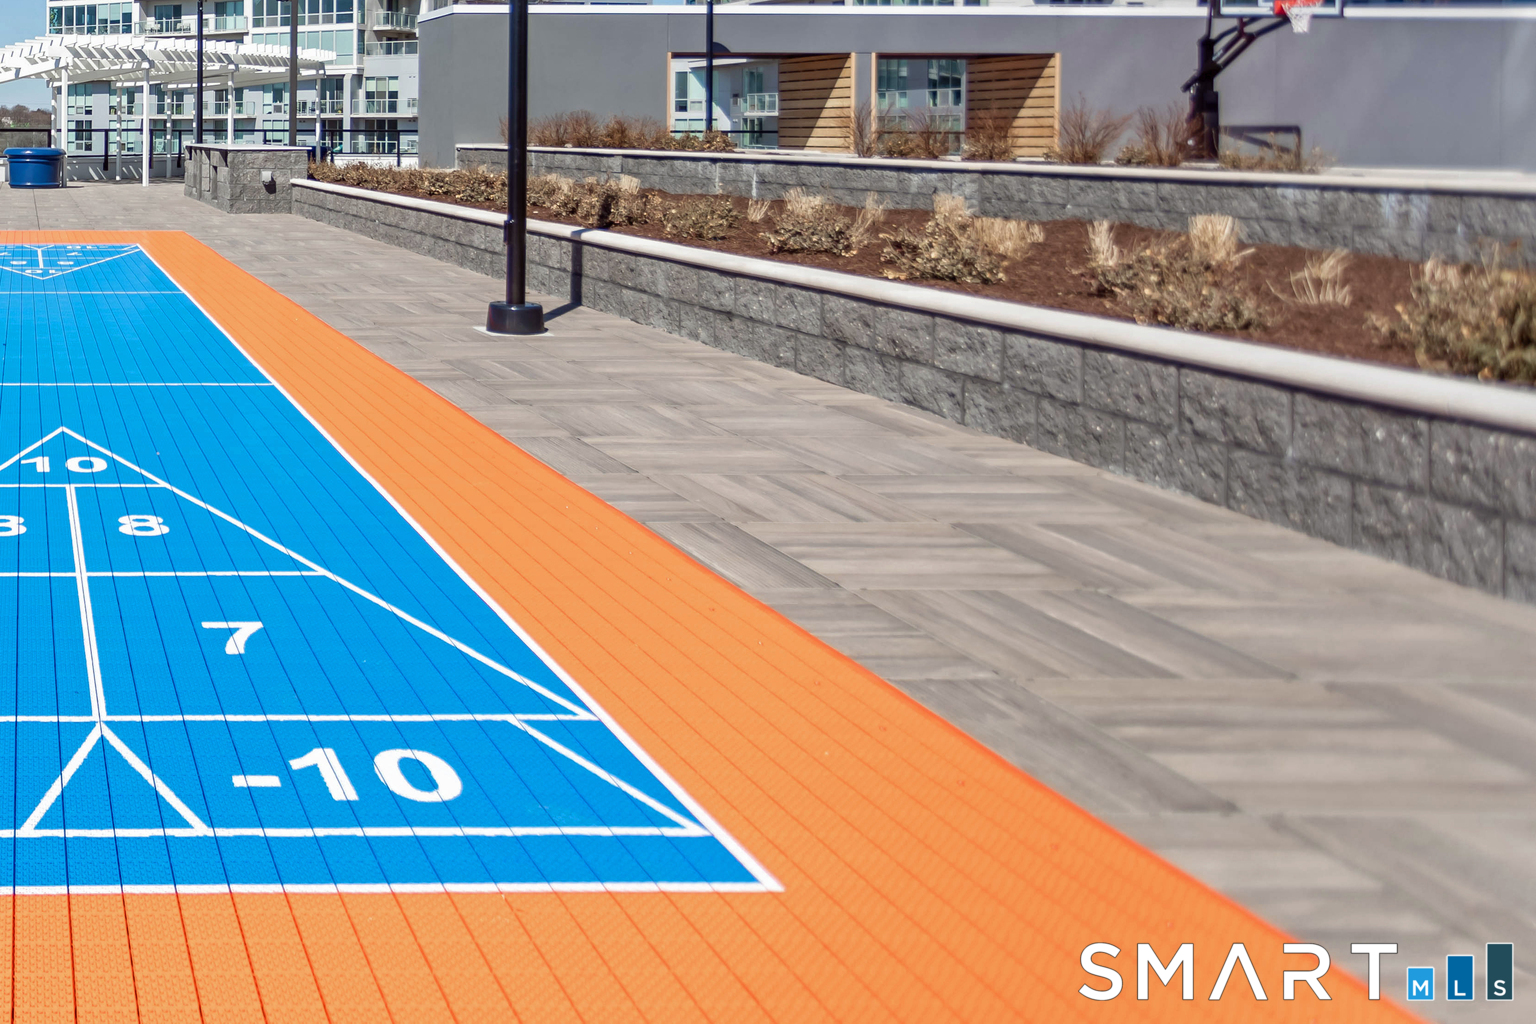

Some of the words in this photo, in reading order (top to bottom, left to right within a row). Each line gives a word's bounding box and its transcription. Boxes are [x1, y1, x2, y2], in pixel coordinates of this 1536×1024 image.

[21, 456, 108, 474] 10
[118, 514, 170, 537] 8
[201, 621, 264, 655] 7
[232, 747, 464, 802] -10
